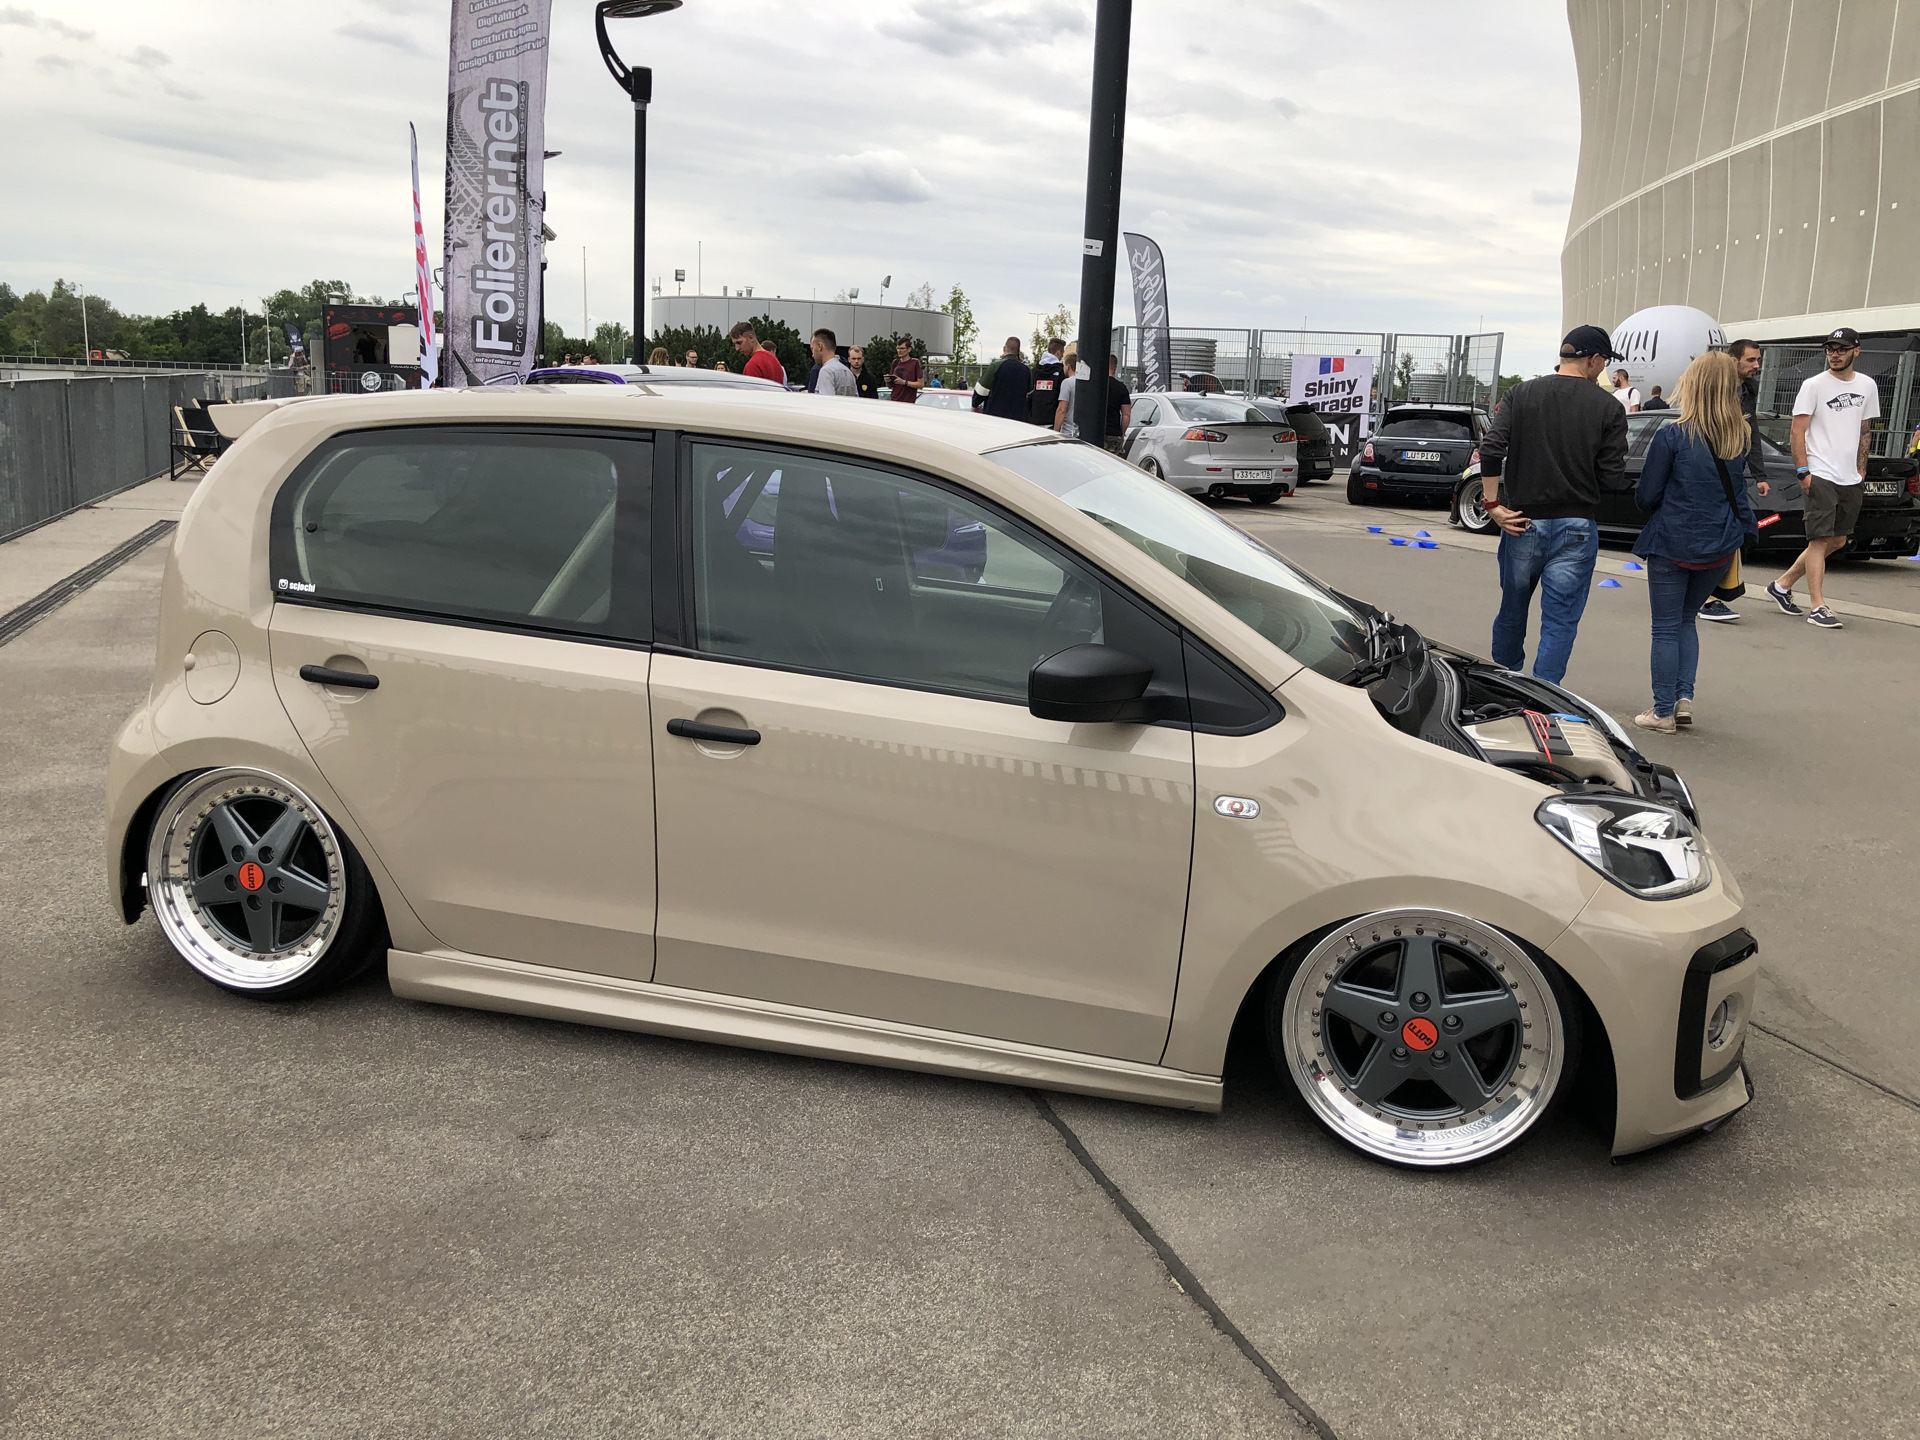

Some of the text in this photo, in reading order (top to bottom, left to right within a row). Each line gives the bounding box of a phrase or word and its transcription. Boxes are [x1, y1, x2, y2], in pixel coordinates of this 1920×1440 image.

[478, 6, 527, 28] Digitaldruck
[458, 56, 488, 71] Design
[476, 82, 519, 351] Folierer.net
[515, 258, 526, 352] Professionelle
[1304, 377, 1358, 397] Shiny
[247, 864, 256, 889] GOTTI
[1407, 1021, 1434, 1047] GOTTI
